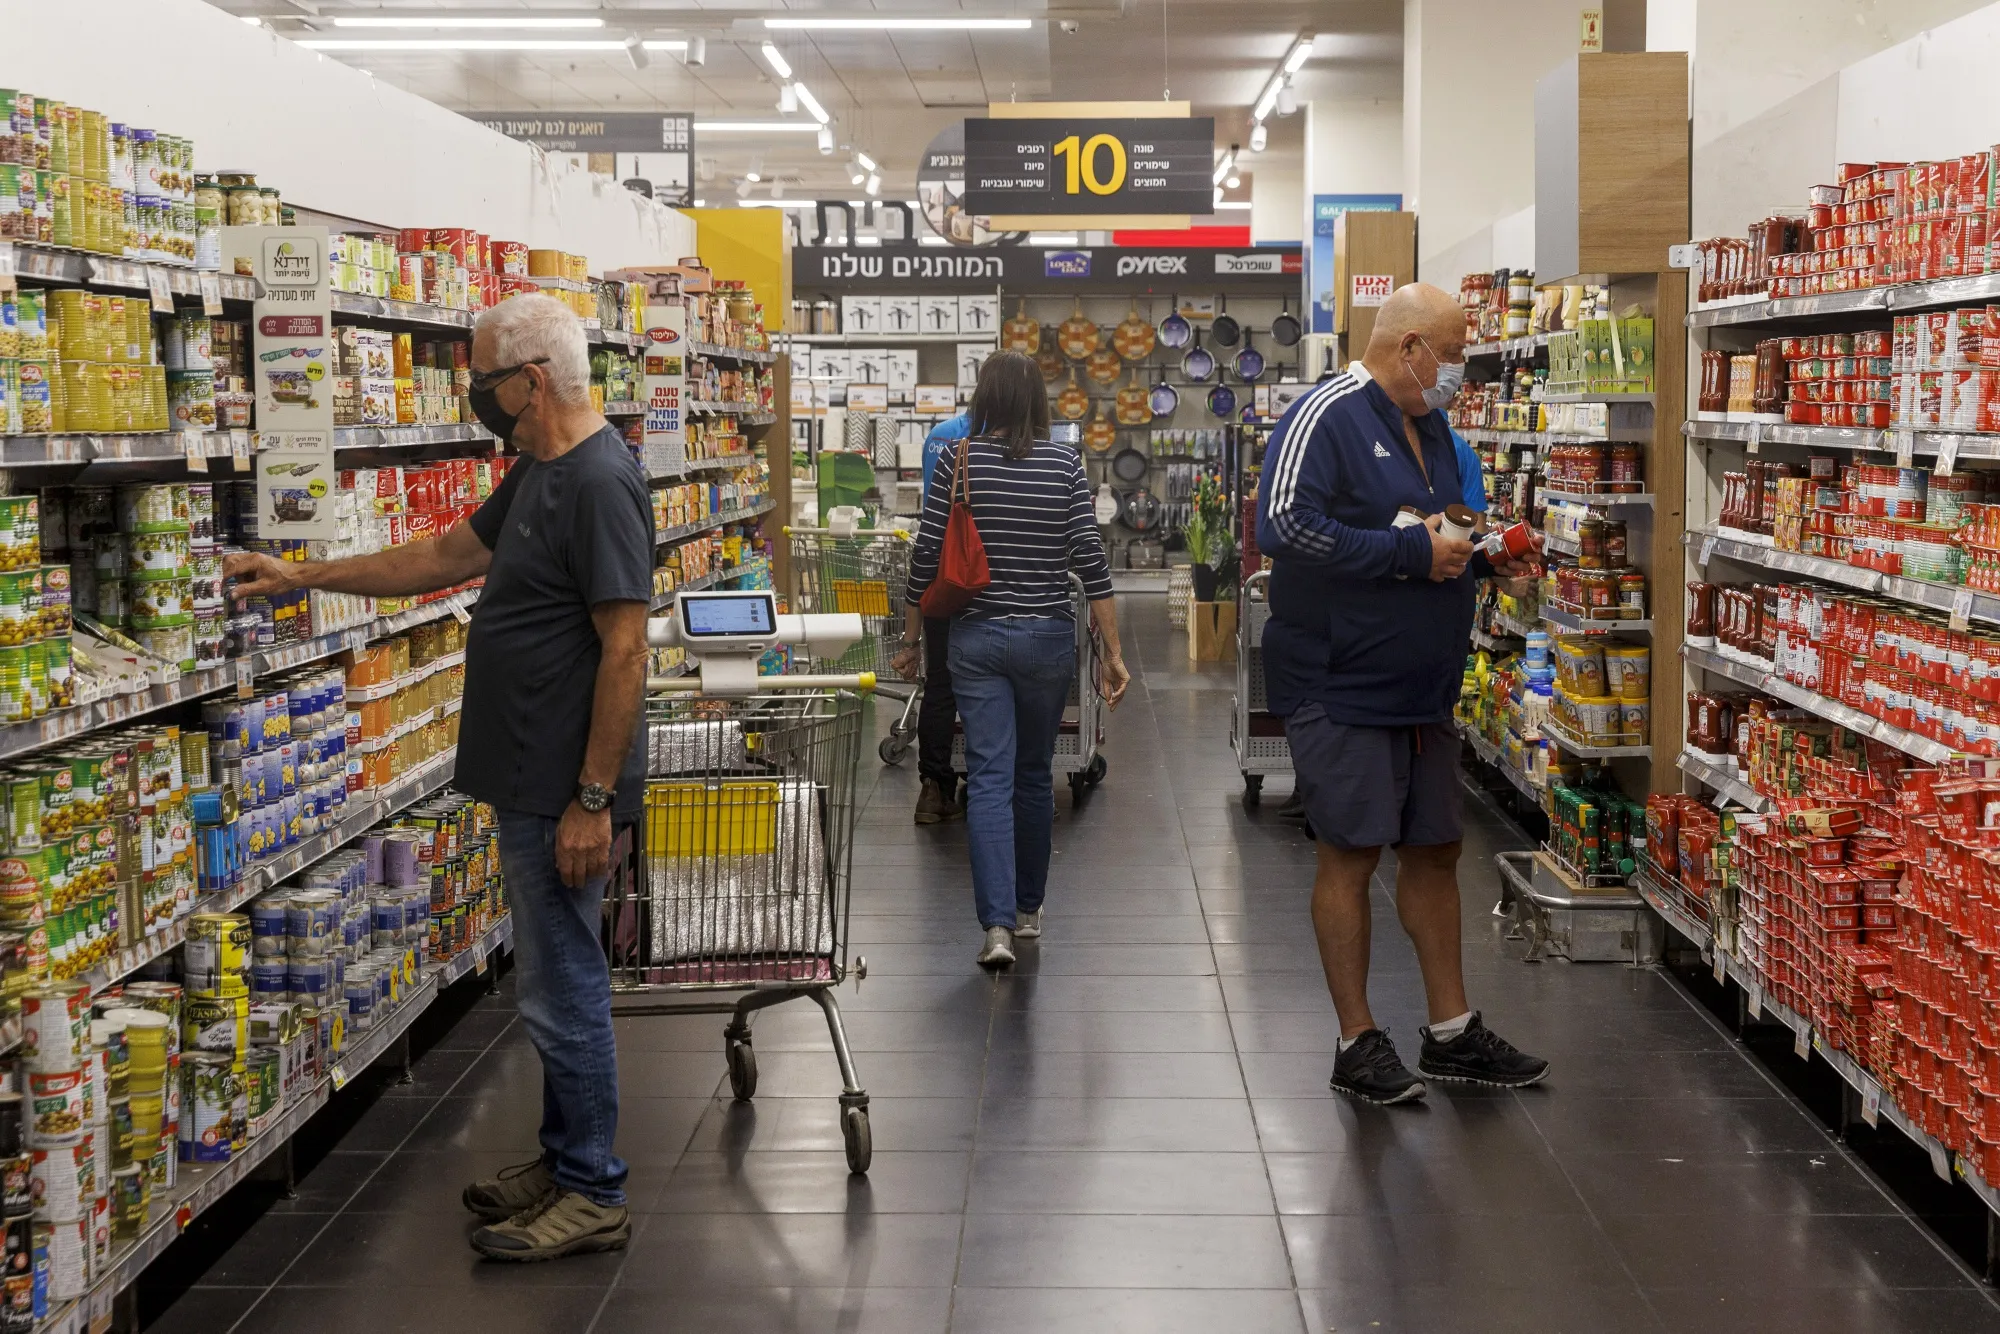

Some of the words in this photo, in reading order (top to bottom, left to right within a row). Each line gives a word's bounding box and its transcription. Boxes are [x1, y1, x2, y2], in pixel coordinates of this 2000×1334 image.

[505, 119, 542, 135] לעיצוב
[545, 120, 565, 135] לכם
[568, 121, 604, 135] דואגים
[1017, 144, 1045, 154] רטבים
[1133, 144, 1154, 153] טונה
[1024, 161, 1044, 171] מיונז
[1053, 133, 1127, 195] 10
[1133, 160, 1170, 170] שימורים
[981, 179, 1014, 188] עגבניות
[1015, 179, 1045, 188] שימורי
[1133, 178, 1166, 187] חמוצים
[822, 252, 883, 278] שלנו
[892, 256, 1004, 278] המותגים
[1050, 260, 1074, 269] LOCK
[1117, 255, 1187, 277] pyrex
[1226, 259, 1272, 271] שופרסל
[1060, 266, 1085, 274] LOCK
[1355, 277, 1390, 286] אש
[268, 289, 298, 301] מעדניה
[300, 289, 316, 301] זיתי
[1355, 286, 1391, 296] FIRE
[307, 367, 322, 375] חדש
[655, 387, 678, 397] טעם
[650, 398, 678, 408] מנצח
[652, 409, 678, 419] מחיר
[646, 420, 678, 431] מנצח!
[309, 484, 325, 492] חדש
[207, 1033, 233, 1043] Zeytin
